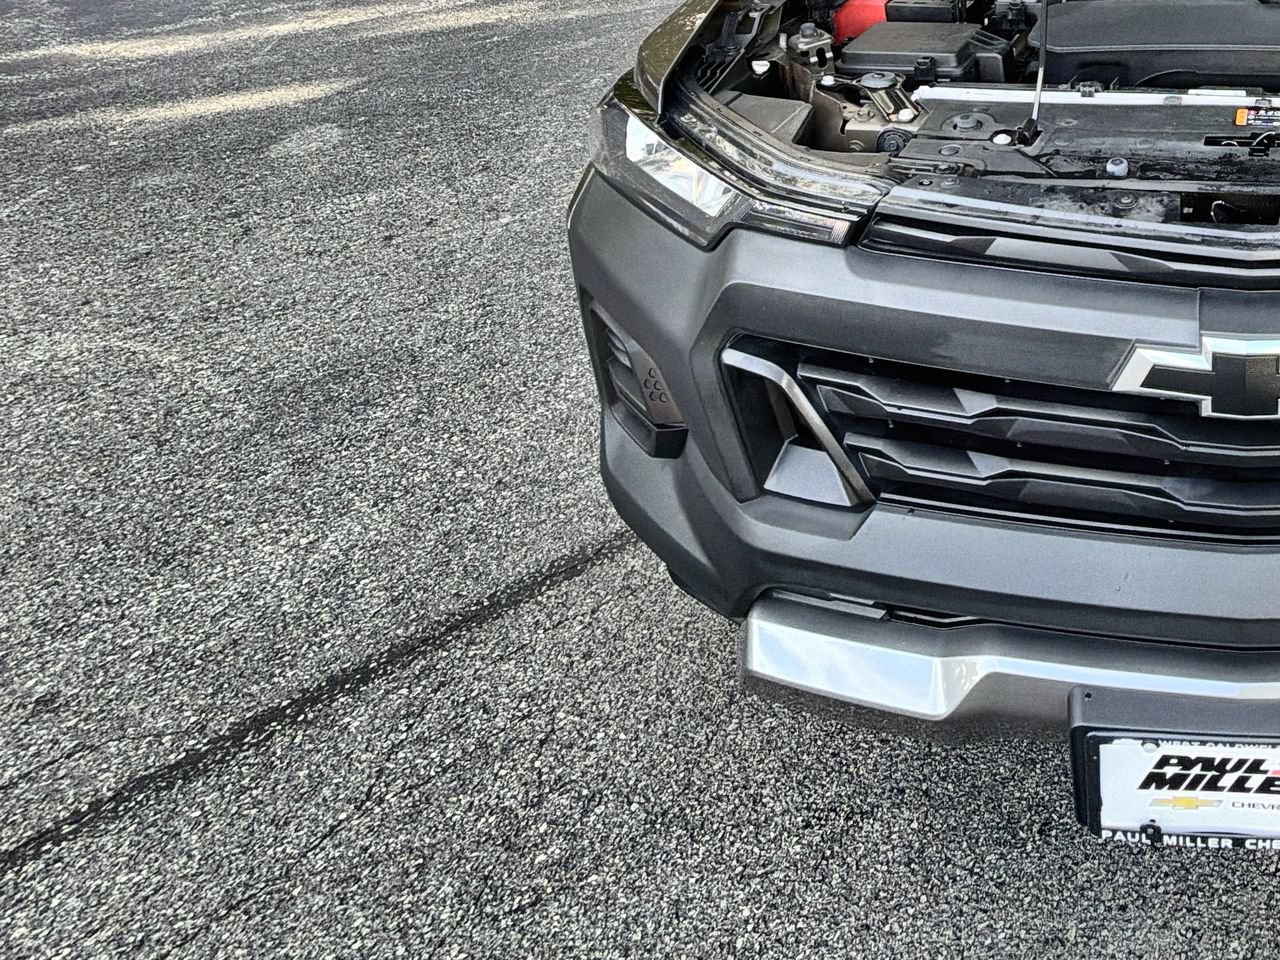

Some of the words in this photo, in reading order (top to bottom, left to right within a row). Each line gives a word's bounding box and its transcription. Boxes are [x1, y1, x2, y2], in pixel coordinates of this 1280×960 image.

[1152, 754, 1270, 775] PAUL
[1101, 829, 1151, 845] PAUL
[1163, 834, 1233, 849] MILLER
